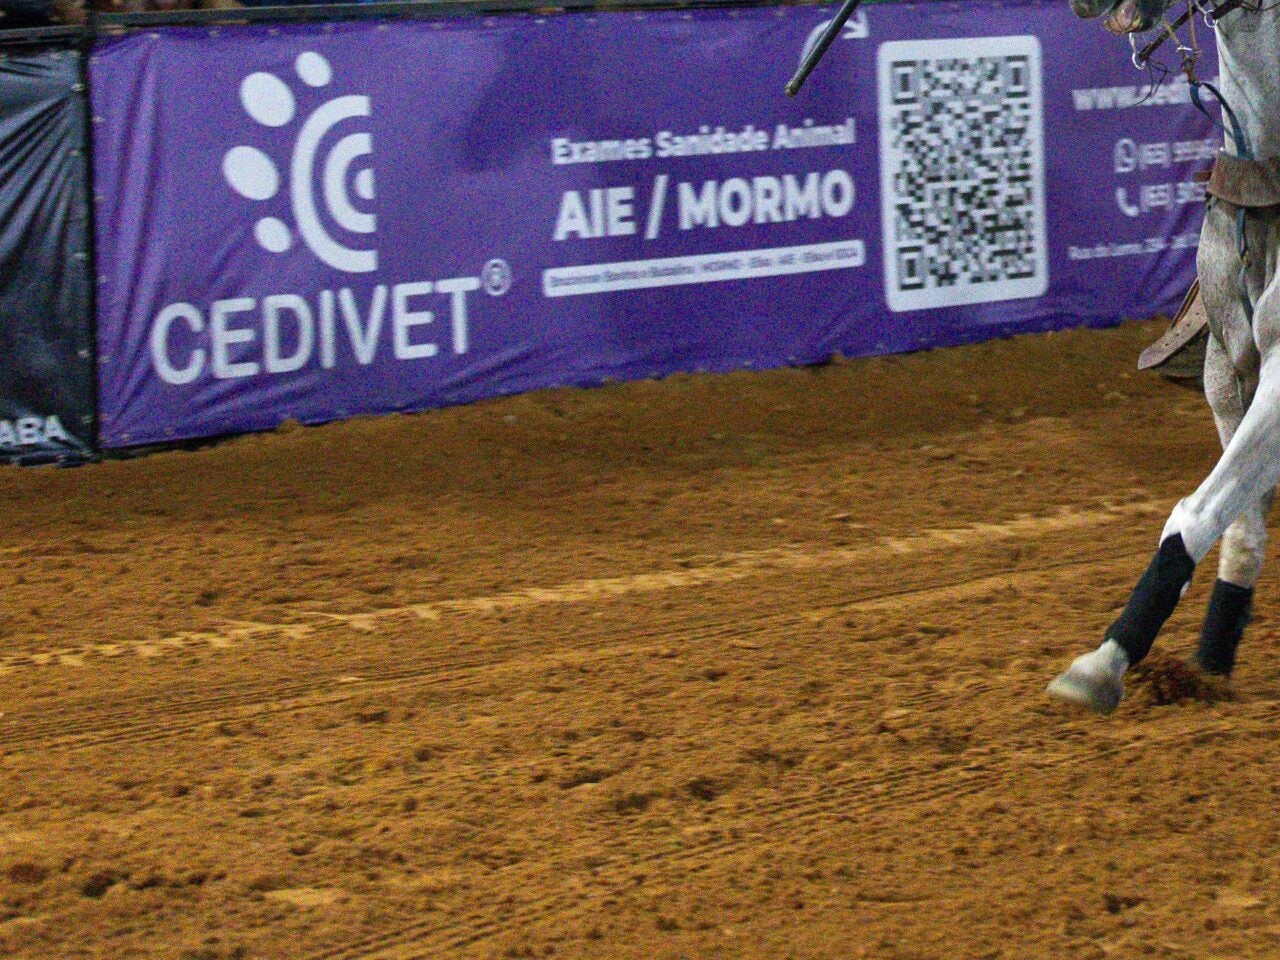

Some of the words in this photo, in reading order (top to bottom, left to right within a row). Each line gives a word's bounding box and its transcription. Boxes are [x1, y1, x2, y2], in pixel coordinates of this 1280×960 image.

[552, 138, 651, 164] Exames
[656, 126, 769, 158] Sanidade
[773, 117, 856, 150] Animal
[553, 186, 637, 241] AIE
[678, 169, 857, 231] MORMO
